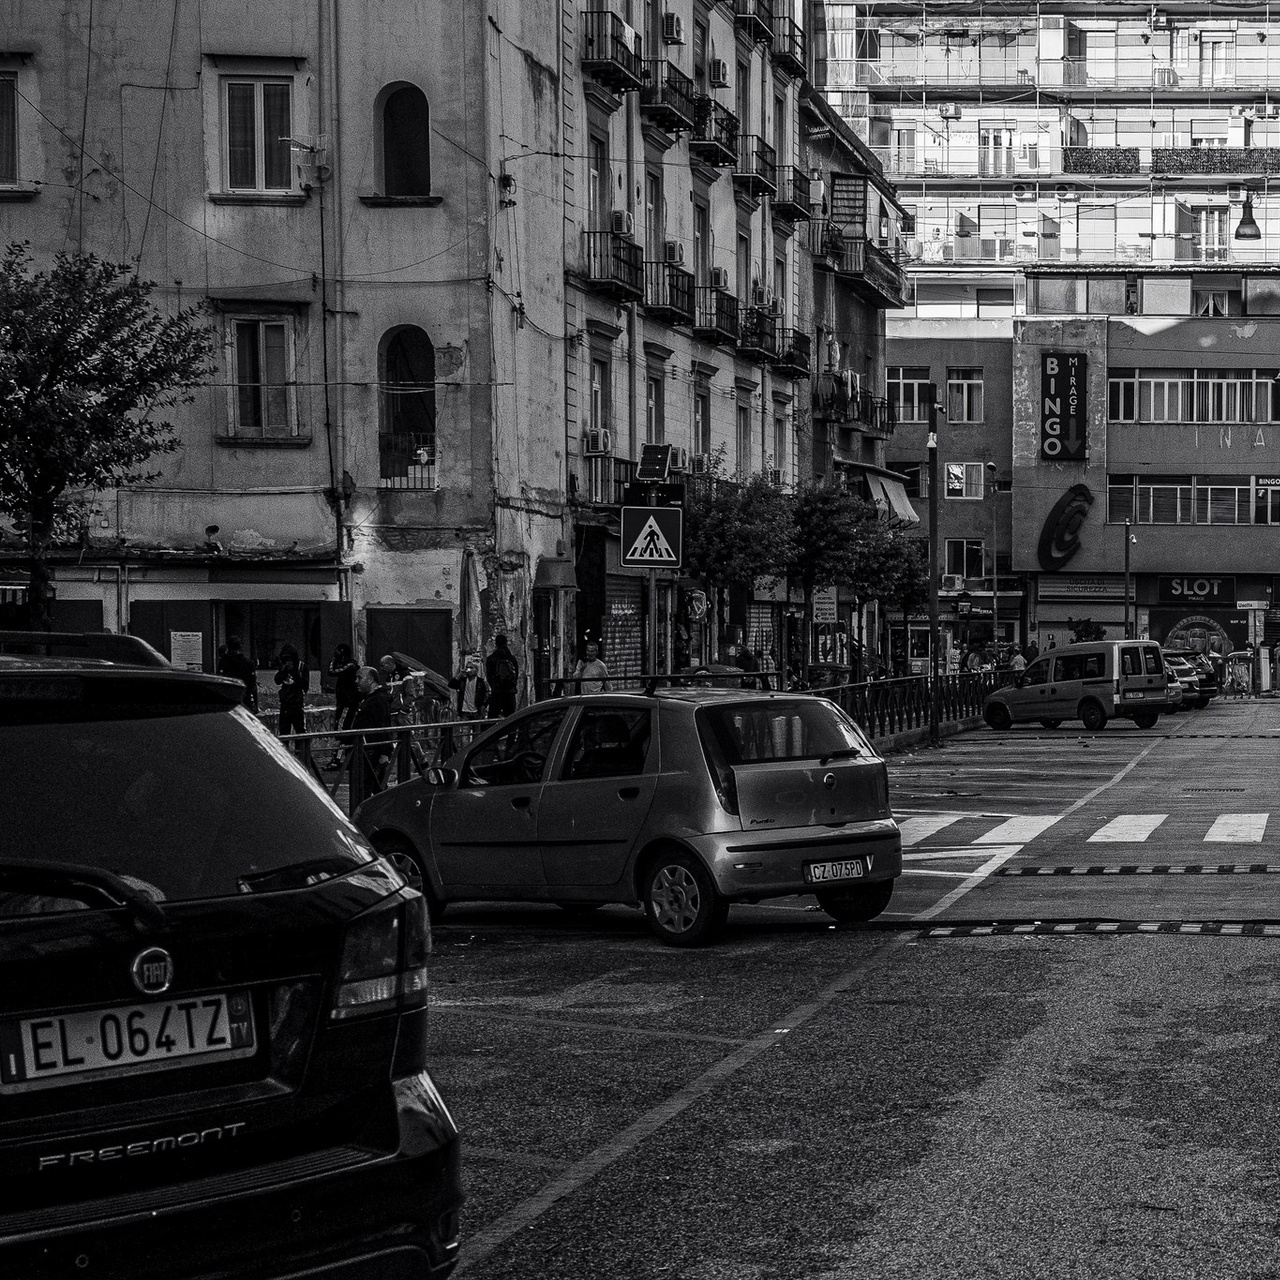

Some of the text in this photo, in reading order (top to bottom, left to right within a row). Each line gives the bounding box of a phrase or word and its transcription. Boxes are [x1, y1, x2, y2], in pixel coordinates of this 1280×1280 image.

[1043, 357, 1062, 455] BINGO
[1068, 357, 1078, 415] MIRAGE
[1171, 579, 1222, 595] SLOT
[31, 1019, 85, 1071] EL
[99, 999, 228, 1061] 064TZ
[39, 1122, 246, 1171] FREEMONT
